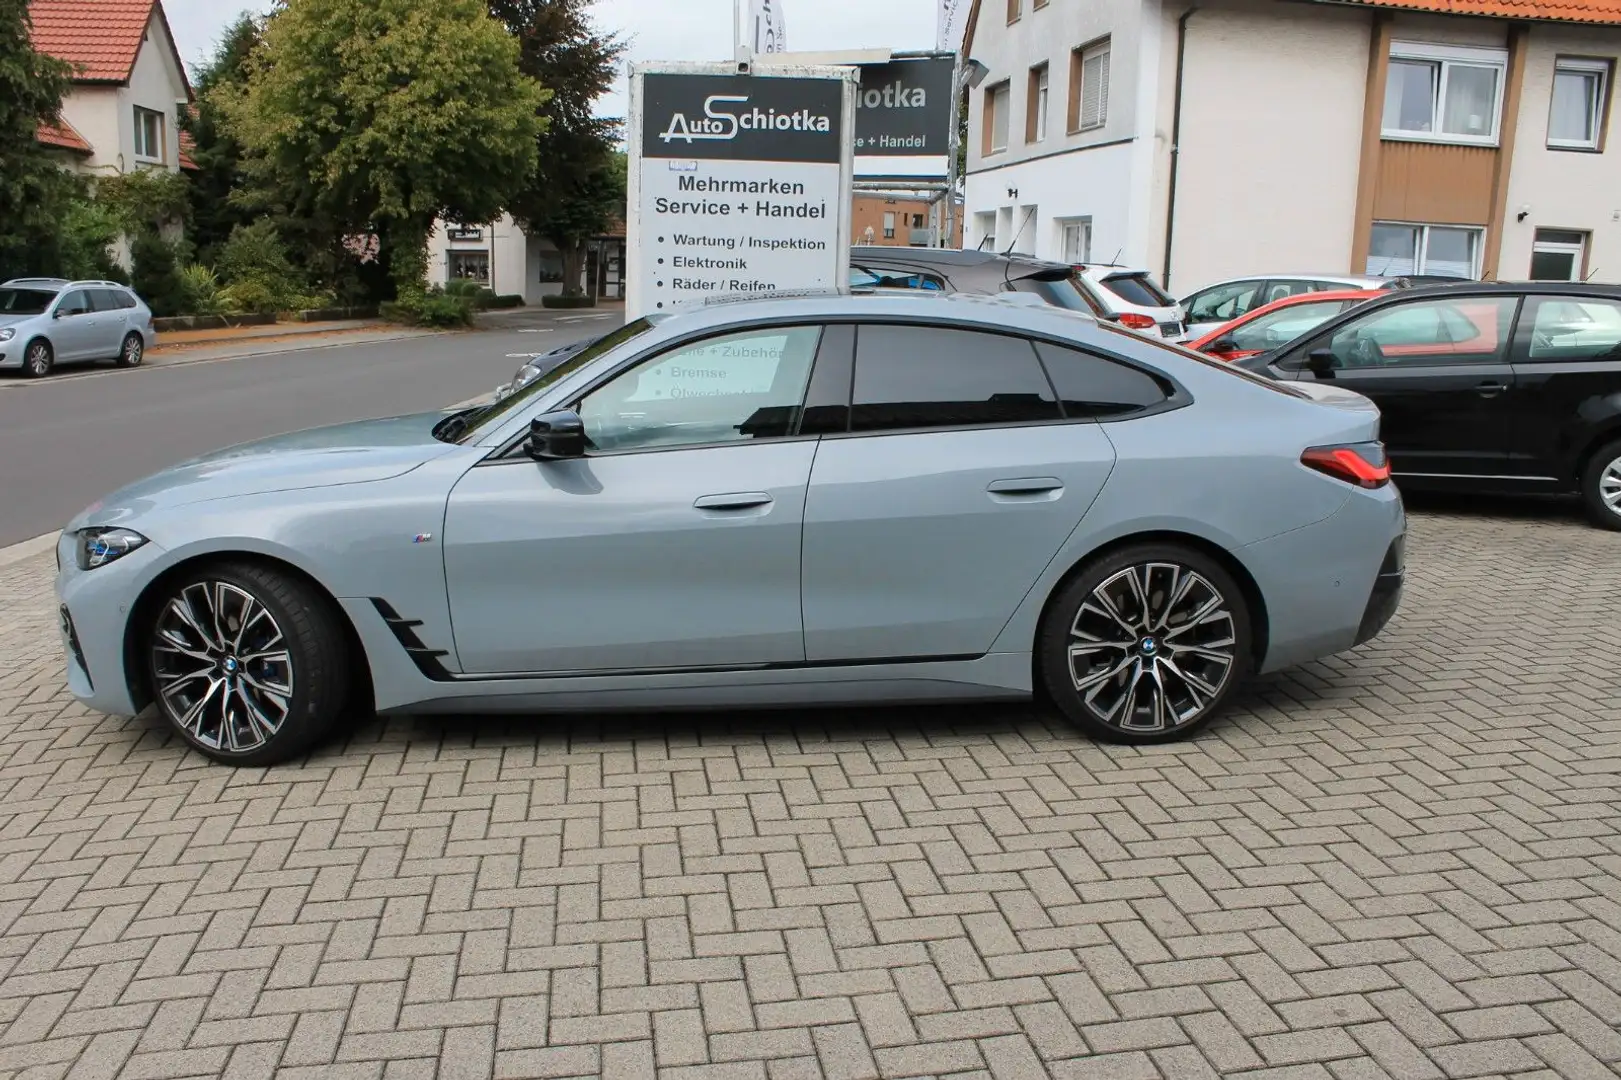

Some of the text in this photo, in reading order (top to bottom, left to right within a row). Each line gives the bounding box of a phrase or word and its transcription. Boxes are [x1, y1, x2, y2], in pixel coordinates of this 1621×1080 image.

[856, 80, 926, 108] iotka
[880, 134, 926, 148] Handel
[678, 175, 804, 195] Mehrmarken
[655, 198, 826, 219] Service + Handel
[673, 234, 735, 249] Wartung
[748, 236, 826, 250] Inspektion
[672, 256, 748, 269] Elektronik
[672, 278, 717, 290] Räder
[729, 280, 776, 291] Reifen
[671, 367, 727, 379] Bremse
